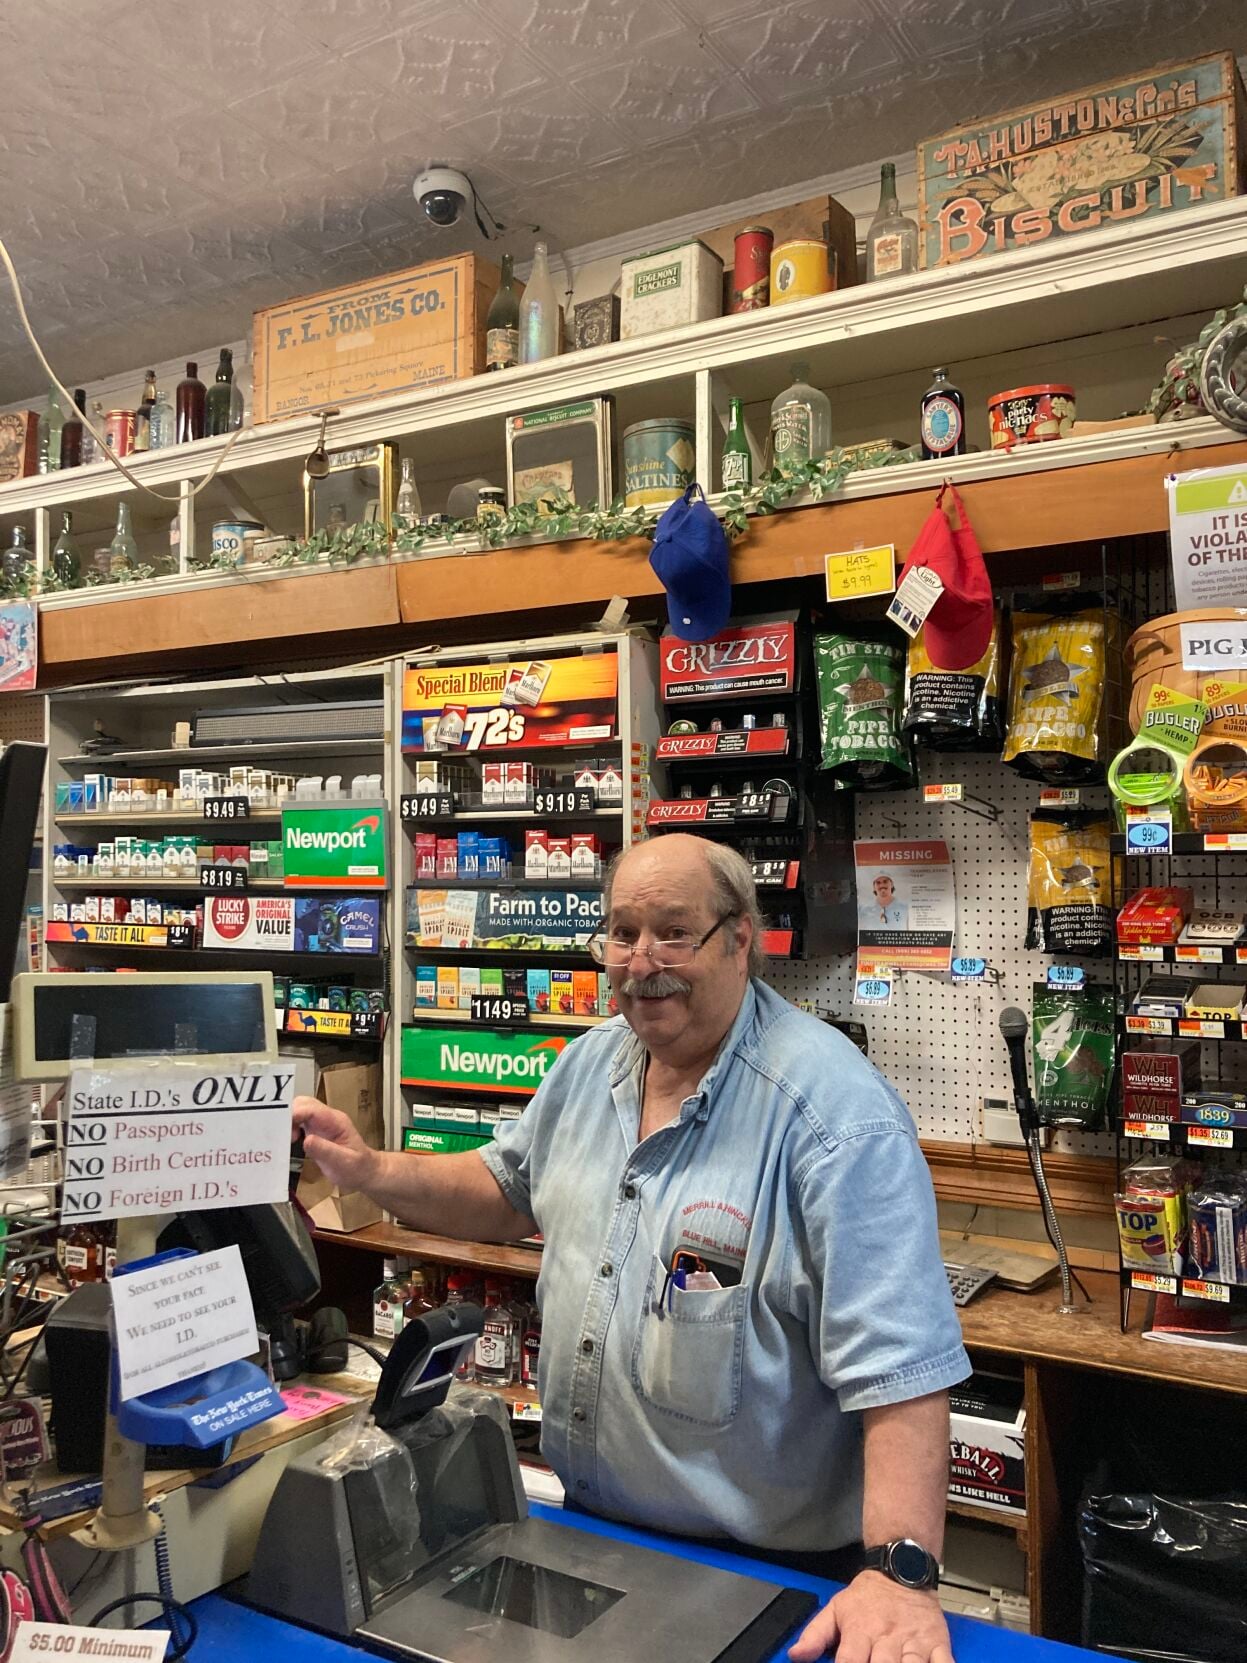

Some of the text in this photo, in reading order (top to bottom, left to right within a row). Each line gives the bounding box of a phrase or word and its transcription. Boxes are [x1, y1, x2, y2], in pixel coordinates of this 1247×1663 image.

[935, 162, 1218, 267] BISCUIT
[638, 266, 678, 285] EDGEMONT
[638, 277, 678, 294] CRACKERS
[327, 291, 391, 313] FROM
[326, 298, 406, 337] JONES
[410, 289, 445, 316] CO.
[276, 365, 446, 411] BANGOR MAINE
[524, 407, 594, 426] NATIONAL BISCUIT COMPANY
[1007, 406, 1034, 420] party
[625, 456, 666, 474] Sunshine
[625, 473, 689, 493] SALTINES
[1212, 515, 1230, 531] IT
[847, 555, 871, 567] HATS
[1187, 552, 1212, 567] OF
[841, 574, 872, 589] $9.99
[920, 571, 936, 586] Light
[665, 634, 789, 675] GRIZZLY
[829, 643, 856, 661] TIN
[1188, 638, 1233, 656] PIG
[416, 670, 507, 700] Special Blend
[695, 683, 705, 692] This
[705, 682, 724, 693] product
[734, 681, 749, 689] cause
[749, 678, 765, 687] mouth
[916, 675, 955, 684] WARNING:
[941, 682, 975, 691] contains
[933, 695, 969, 704] addictive
[943, 688, 976, 698] Nicotine
[920, 702, 958, 711] chemical.
[1024, 706, 1069, 721] PIPE
[464, 707, 526, 751] 72's
[847, 720, 889, 735] PIPE
[1145, 710, 1201, 737] BUGLER
[1164, 728, 1189, 744] HEMP
[659, 737, 716, 754] GRIZZLY
[205, 801, 235, 818] $9.49
[401, 797, 437, 817] $9.49
[535, 792, 576, 813] $9.19
[650, 803, 708, 818] GRIZZLY
[286, 827, 367, 853] Newport
[879, 850, 933, 861] MISSING
[1148, 846, 1169, 854] ITEM
[202, 869, 232, 887] $8.19
[217, 900, 244, 912] LUCKY
[256, 900, 291, 909] AMERICA'S
[489, 893, 536, 915] Farm
[539, 893, 562, 915] to
[1051, 906, 1095, 915] WARNING:
[216, 912, 245, 925] STRIKE
[255, 909, 291, 919] ORIGINAL
[340, 911, 375, 927] CAMEL
[1050, 915, 1080, 925] product
[256, 919, 291, 935] VALUE
[489, 918, 573, 928] MADE WITH ORGANIC
[1050, 923, 1083, 932] nicotine.
[95, 926, 145, 943] TASTE IT ALL
[447, 926, 470, 938] SPIRIT
[1055, 931, 1063, 939] is
[959, 958, 977, 972] $6.89
[560, 973, 571, 981] OFF
[865, 981, 881, 995] $6.89
[320, 1017, 344, 1028] TASTE IT
[440, 1044, 548, 1080] Newport
[1127, 1074, 1174, 1085] WILDHORSE
[73, 1074, 294, 1111] State I.D.'s ONLY
[413, 1108, 432, 1117] Newport
[500, 1108, 520, 1117] Newport
[1234, 1101, 1246, 1109] 200
[455, 1112, 475, 1121] Newport
[1128, 1112, 1174, 1122] WILDHORSE
[1199, 1108, 1230, 1123] 1839
[68, 1120, 204, 1143] NO Passports
[1211, 1130, 1229, 1141] $2.69
[408, 1141, 434, 1150] MENTHOL
[409, 1134, 444, 1145] ORIGINAL
[66, 1149, 273, 1177] NO Birth Certificates
[64, 1180, 240, 1212] NO Foreign I.D.'s
[682, 1200, 716, 1216] MERRILL
[1117, 1211, 1159, 1231] TOP
[682, 1229, 701, 1241] BLUE
[128, 1261, 223, 1298] SINCE WE CAN'T SEE
[153, 1286, 206, 1310] YOUR FACE
[126, 1295, 238, 1341] WE NEED TO SEE YOUR
[175, 1327, 199, 1345] I.D.
[191, 1386, 273, 1426] The New York Times
[209, 1420, 225, 1432] ON
[225, 1408, 248, 1425] SALE
[248, 1398, 273, 1414] HERE
[951, 1464, 977, 1478] WHISKY
[962, 1485, 985, 1499] LIKE
[986, 1490, 1011, 1504] HELL
[29, 1633, 153, 1660] $5.00 Minimum
